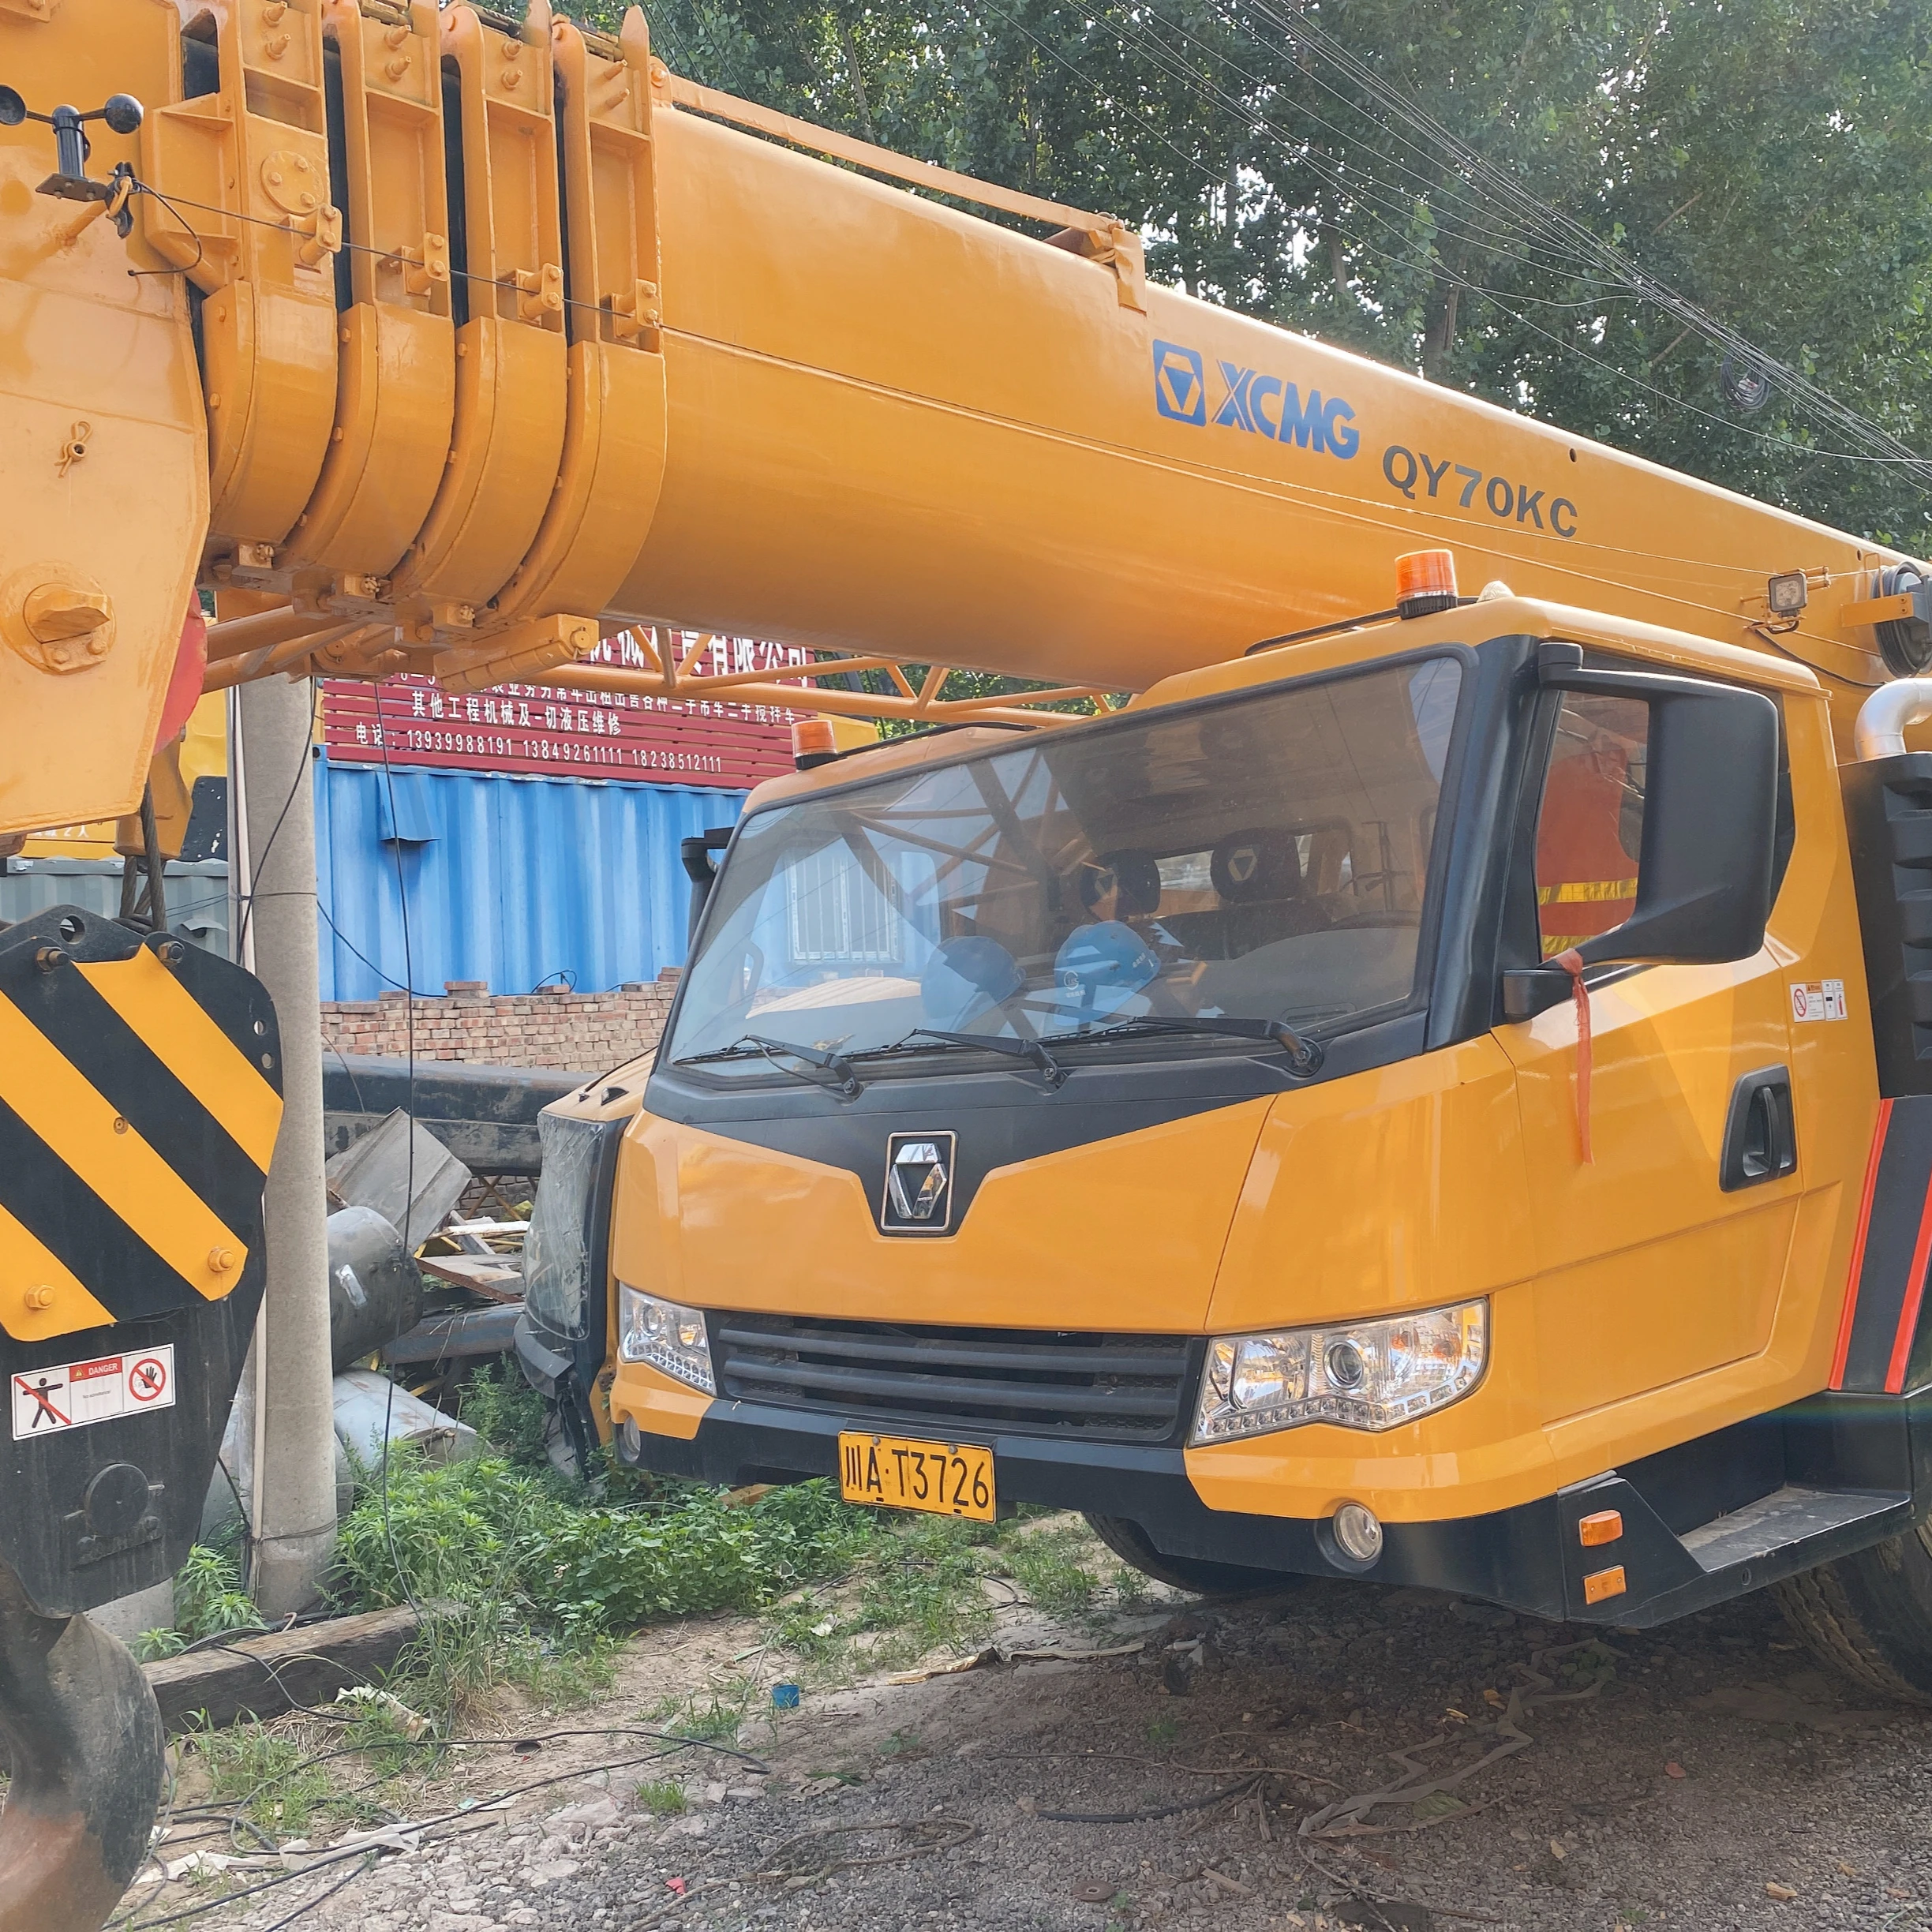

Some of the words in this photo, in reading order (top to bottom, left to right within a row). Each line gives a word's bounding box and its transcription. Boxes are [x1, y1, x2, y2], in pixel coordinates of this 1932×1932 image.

[1212, 358, 1360, 459] XCMG
[1383, 446, 1578, 537] QY70KC
[406, 729, 512, 756] 13939988191
[522, 739, 623, 765] 13849261111
[632, 748, 721, 773] 18238512111
[88, 1363, 118, 1375] DANGER
